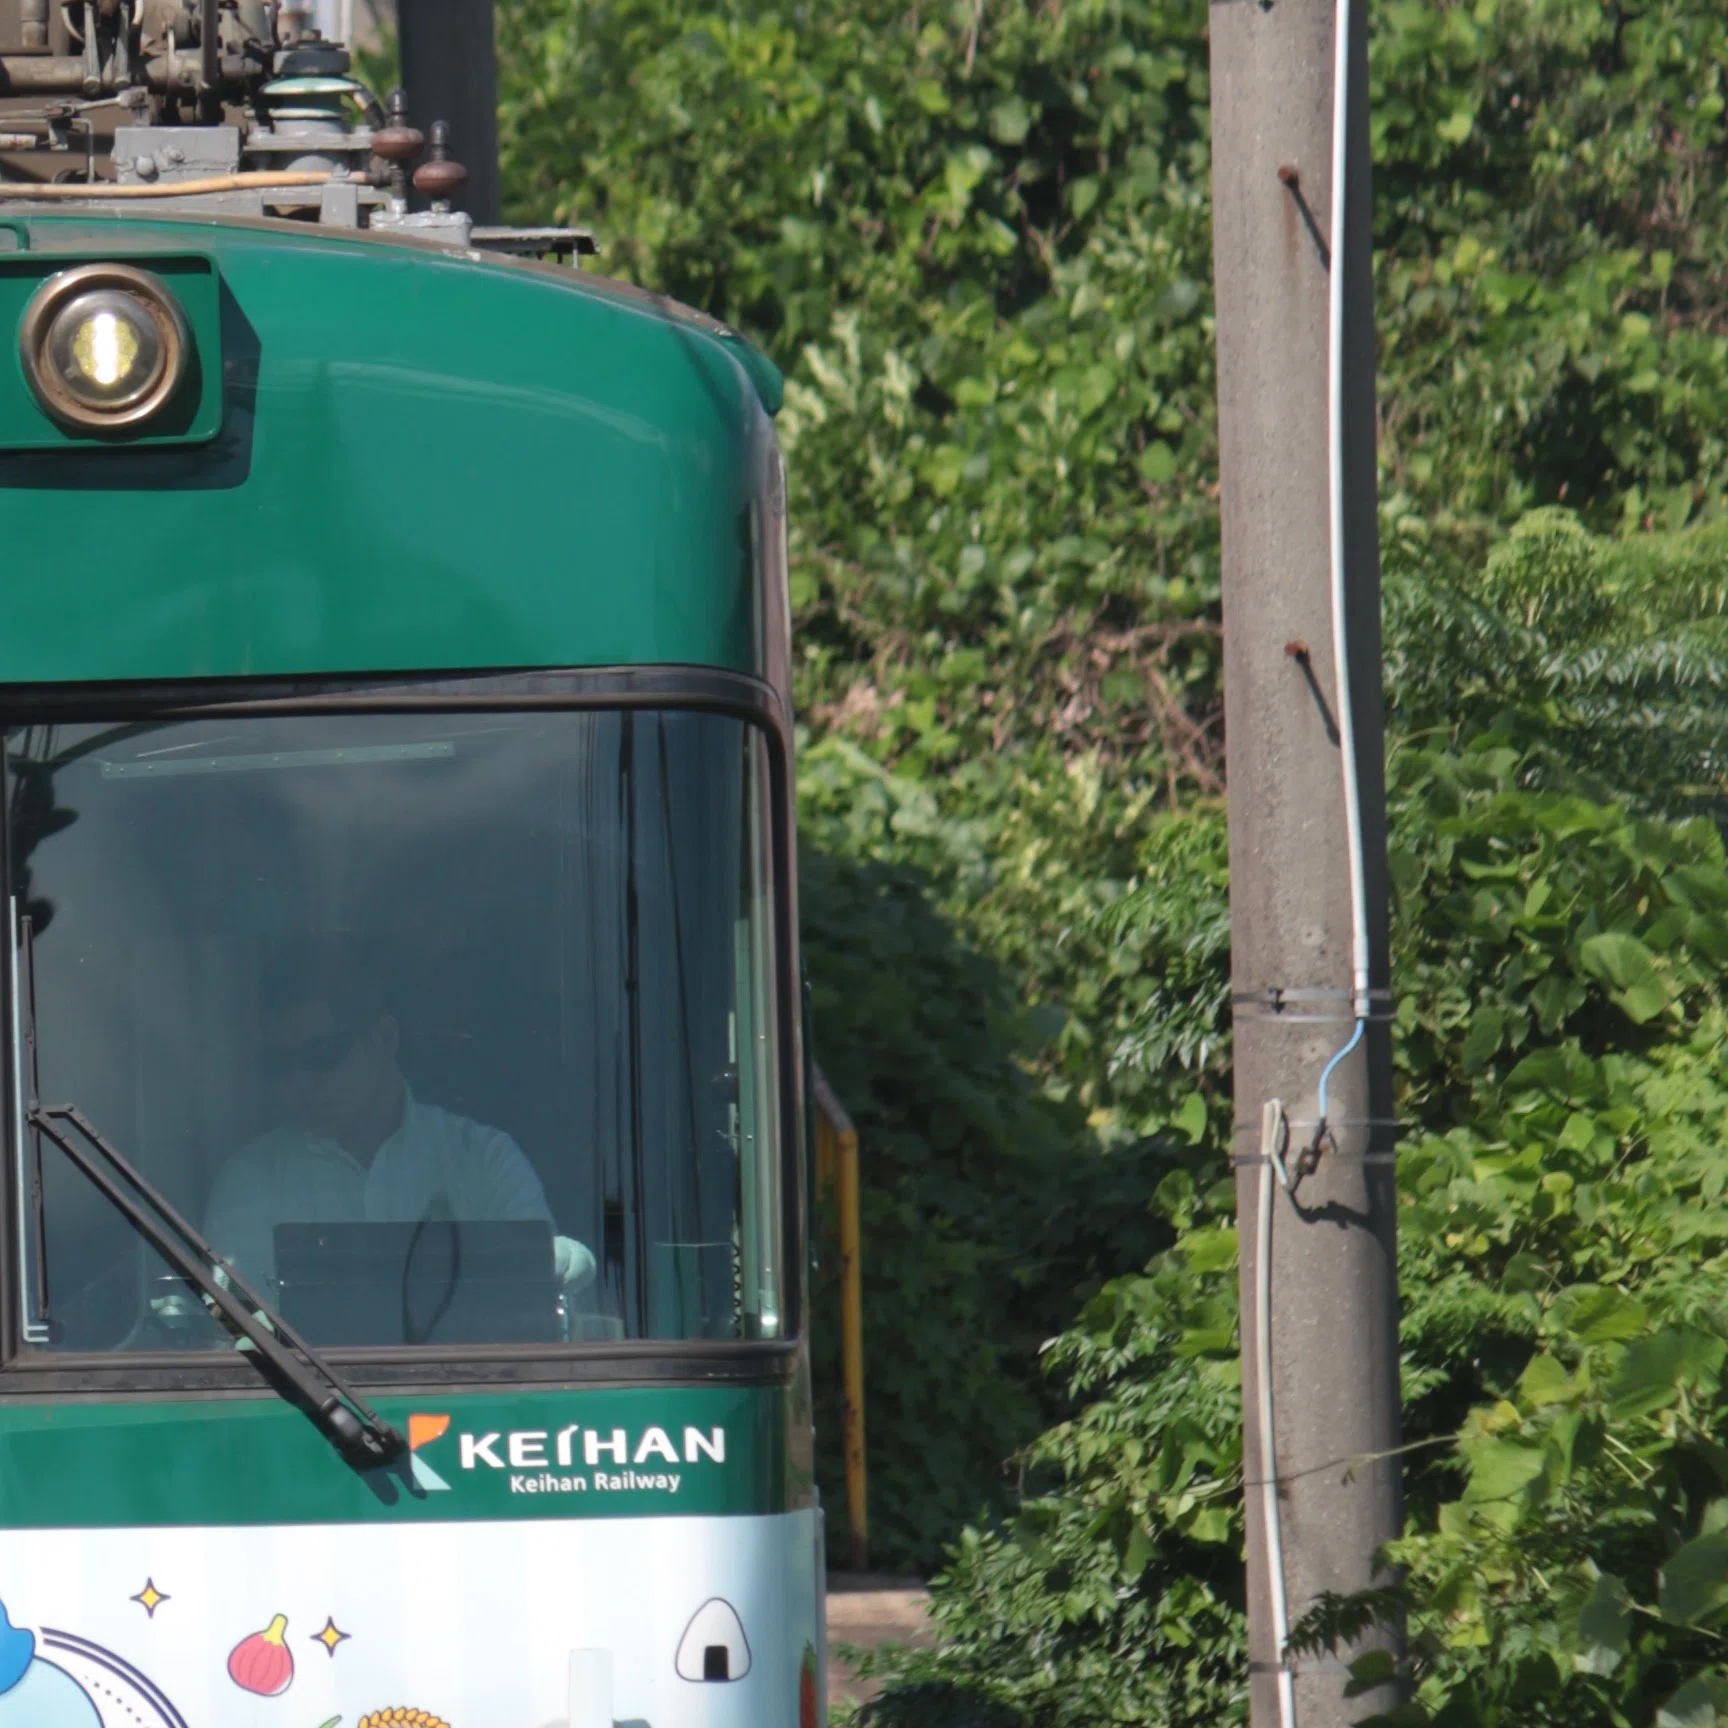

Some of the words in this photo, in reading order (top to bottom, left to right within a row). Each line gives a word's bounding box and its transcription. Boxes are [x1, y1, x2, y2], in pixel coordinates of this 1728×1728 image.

[460, 1424, 725, 1469] KEIHAN
[511, 1473, 587, 1494] Keihan
[594, 1470, 680, 1493] Railway
